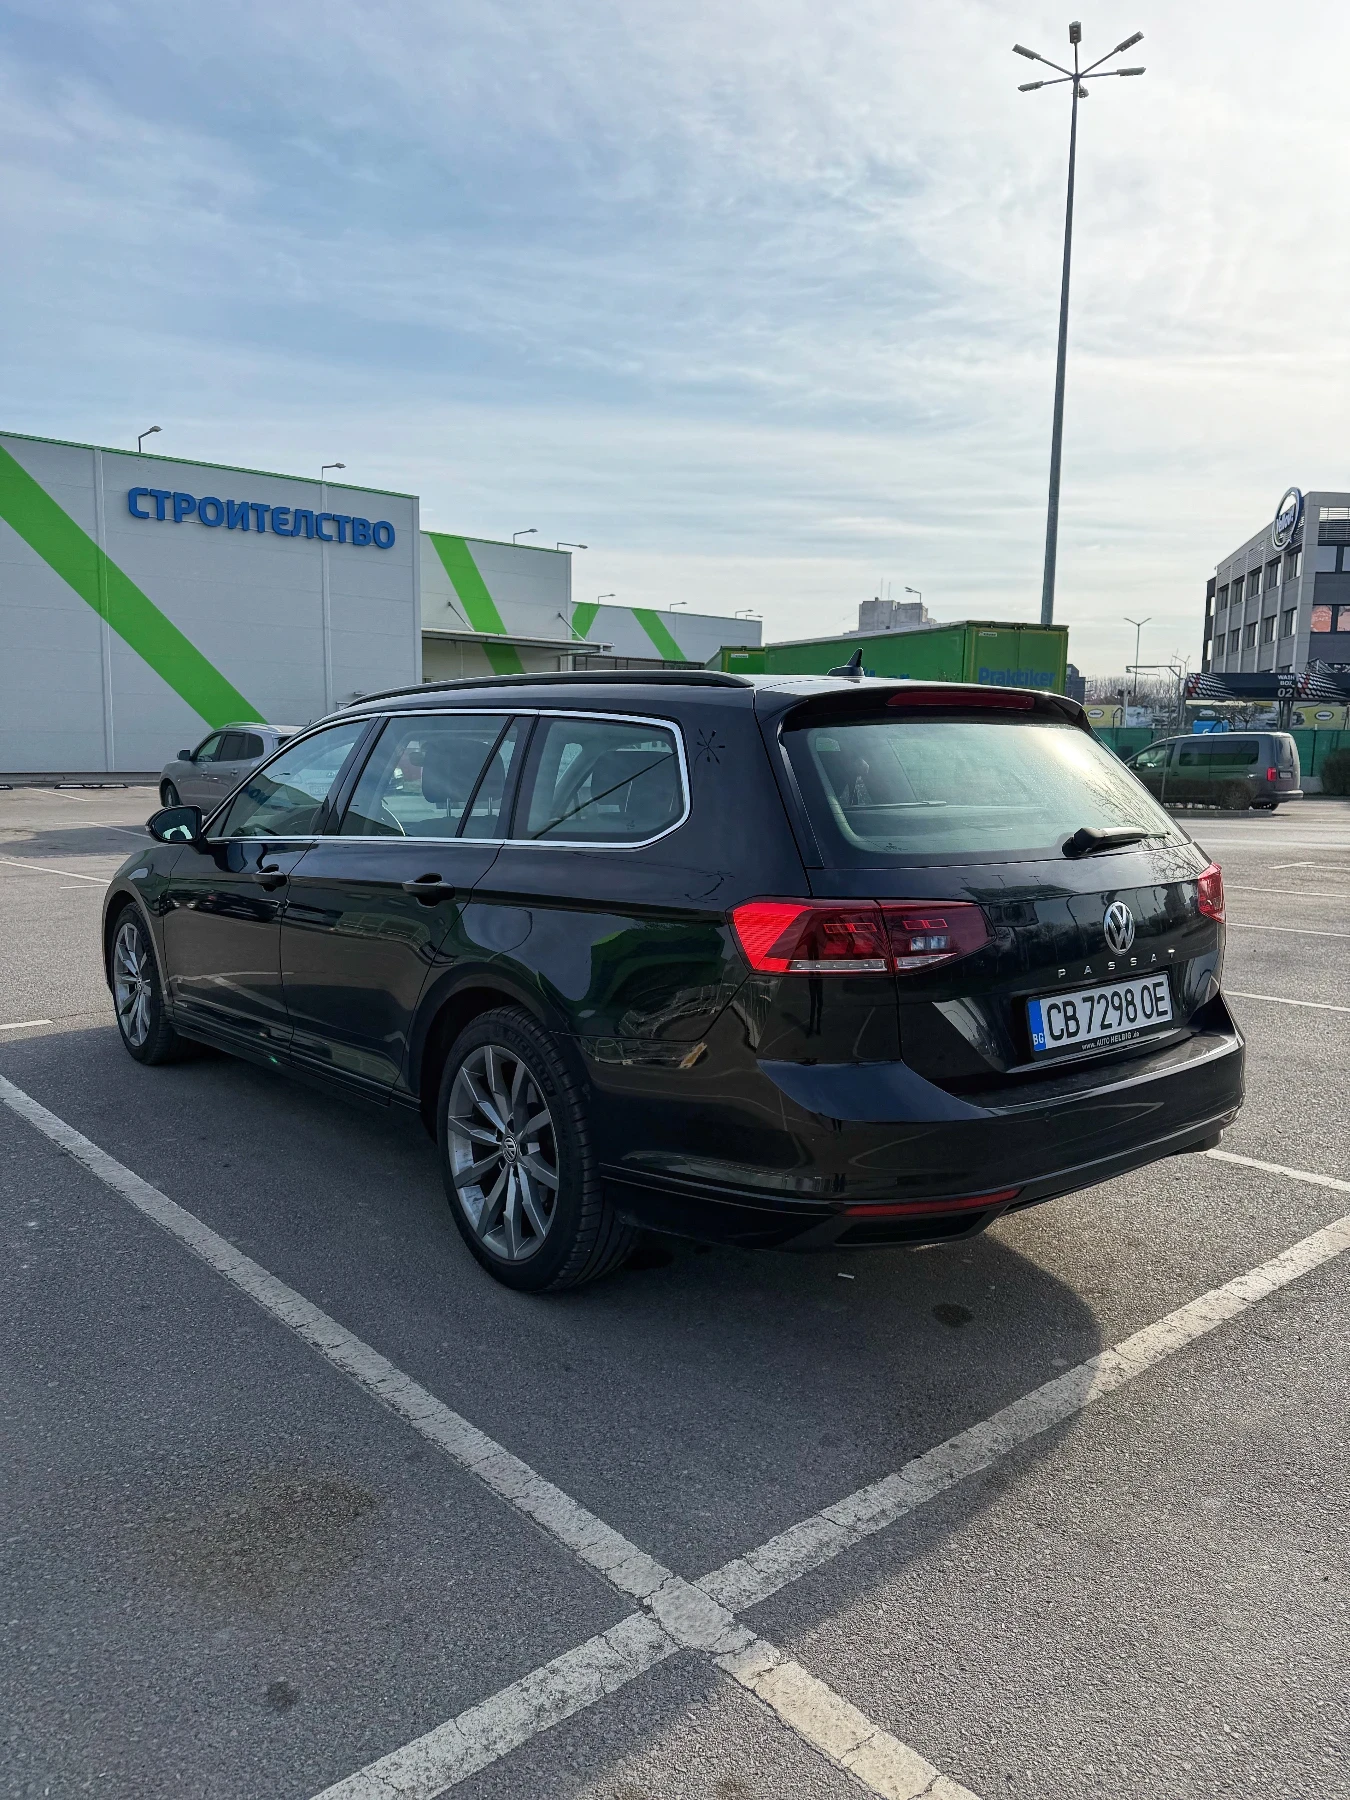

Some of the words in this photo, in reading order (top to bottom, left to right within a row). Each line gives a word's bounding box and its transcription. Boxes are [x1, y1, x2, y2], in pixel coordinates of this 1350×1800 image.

[128, 487, 395, 549] СТРОИТЕЛСТВО
[978, 667, 1056, 687] Praktiker
[1277, 688, 1293, 698] 02
[1058, 949, 1175, 978] PASSAT
[1033, 1031, 1045, 1046] BG
